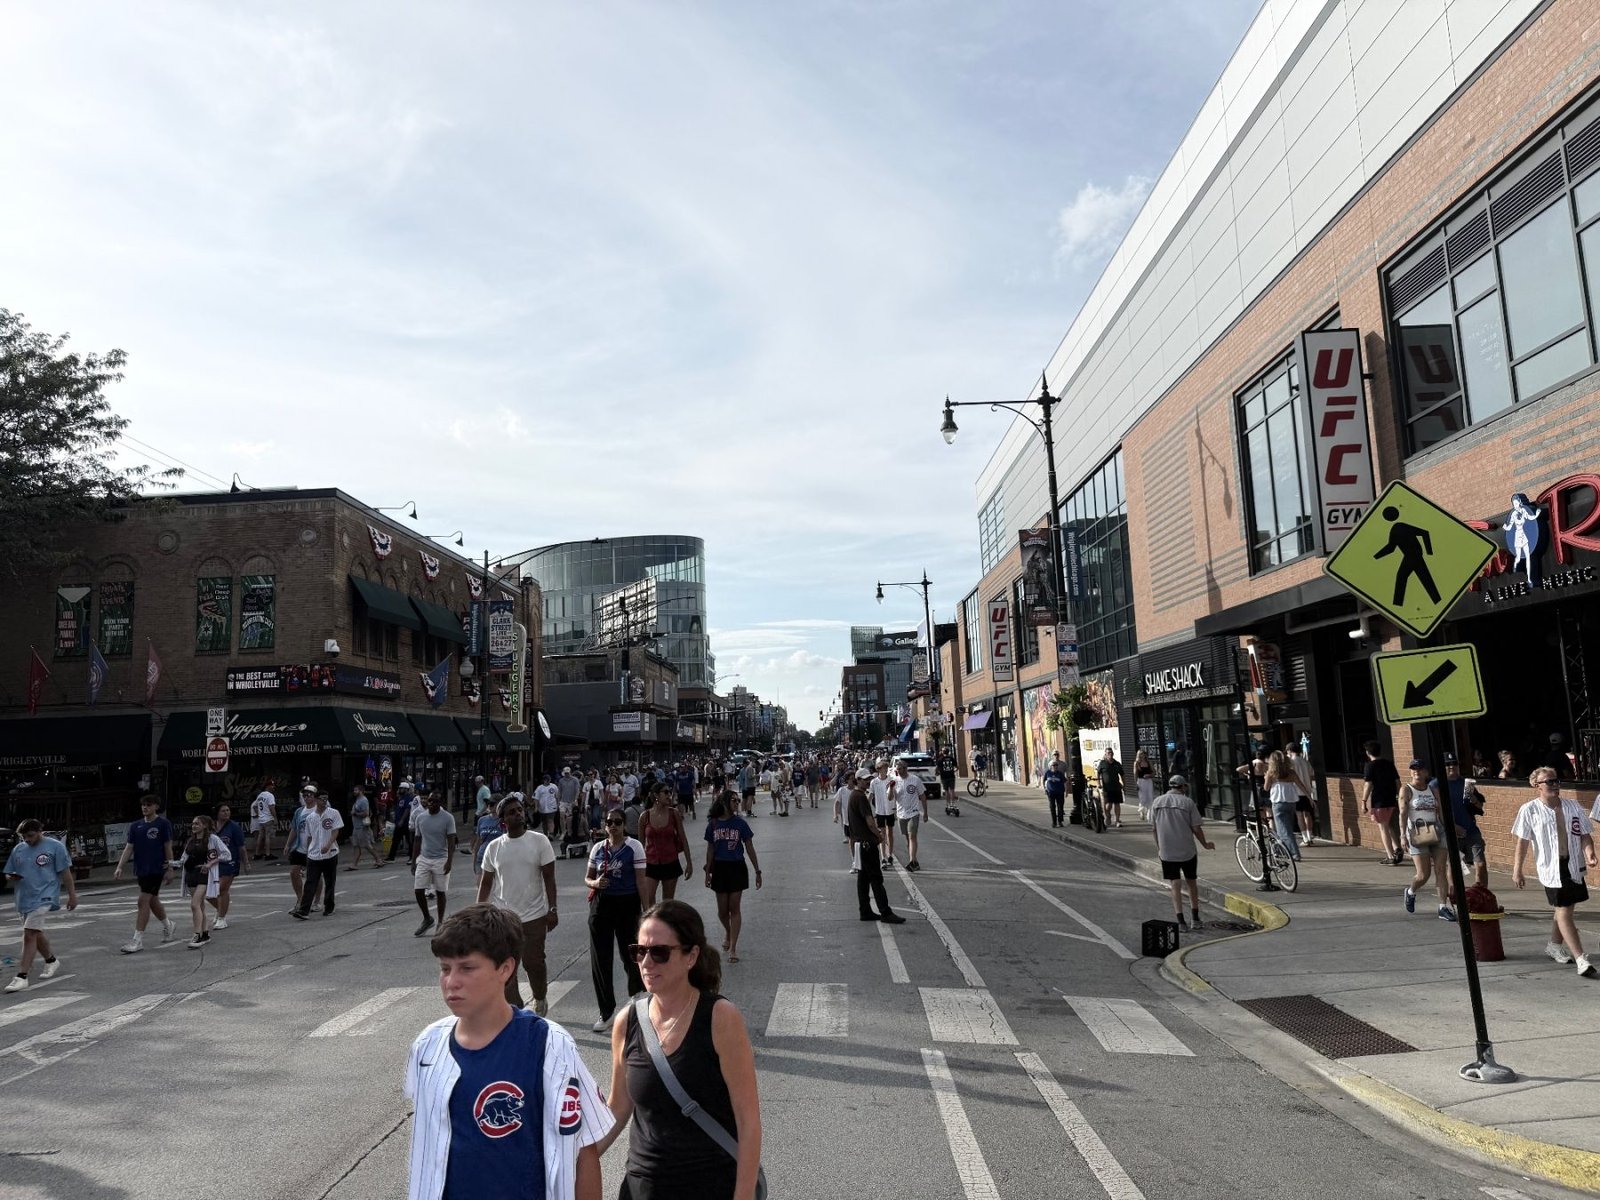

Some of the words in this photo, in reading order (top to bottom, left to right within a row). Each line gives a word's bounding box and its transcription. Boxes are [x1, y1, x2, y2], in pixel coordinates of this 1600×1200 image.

[1312, 348, 1362, 485] UFC
[1498, 582, 1526, 600] LIVE
[1542, 566, 1593, 590] MUSIC
[991, 607, 1008, 657] UFC
[246, 671, 262, 681] BEST
[263, 671, 277, 679] STAFF
[512, 632, 520, 713] SLUGGERS
[994, 664, 1011, 672] GYM
[1145, 669, 1172, 694] SHAKE
[1172, 662, 1204, 691] SHACK
[227, 681, 234, 690] IN
[226, 713, 280, 740] luggers
[234, 746, 263, 757] SPORTS
[264, 746, 279, 755] BAR
[280, 745, 296, 754] AND
[297, 743, 320, 753] GRILL
[380, 791, 389, 800] 27
